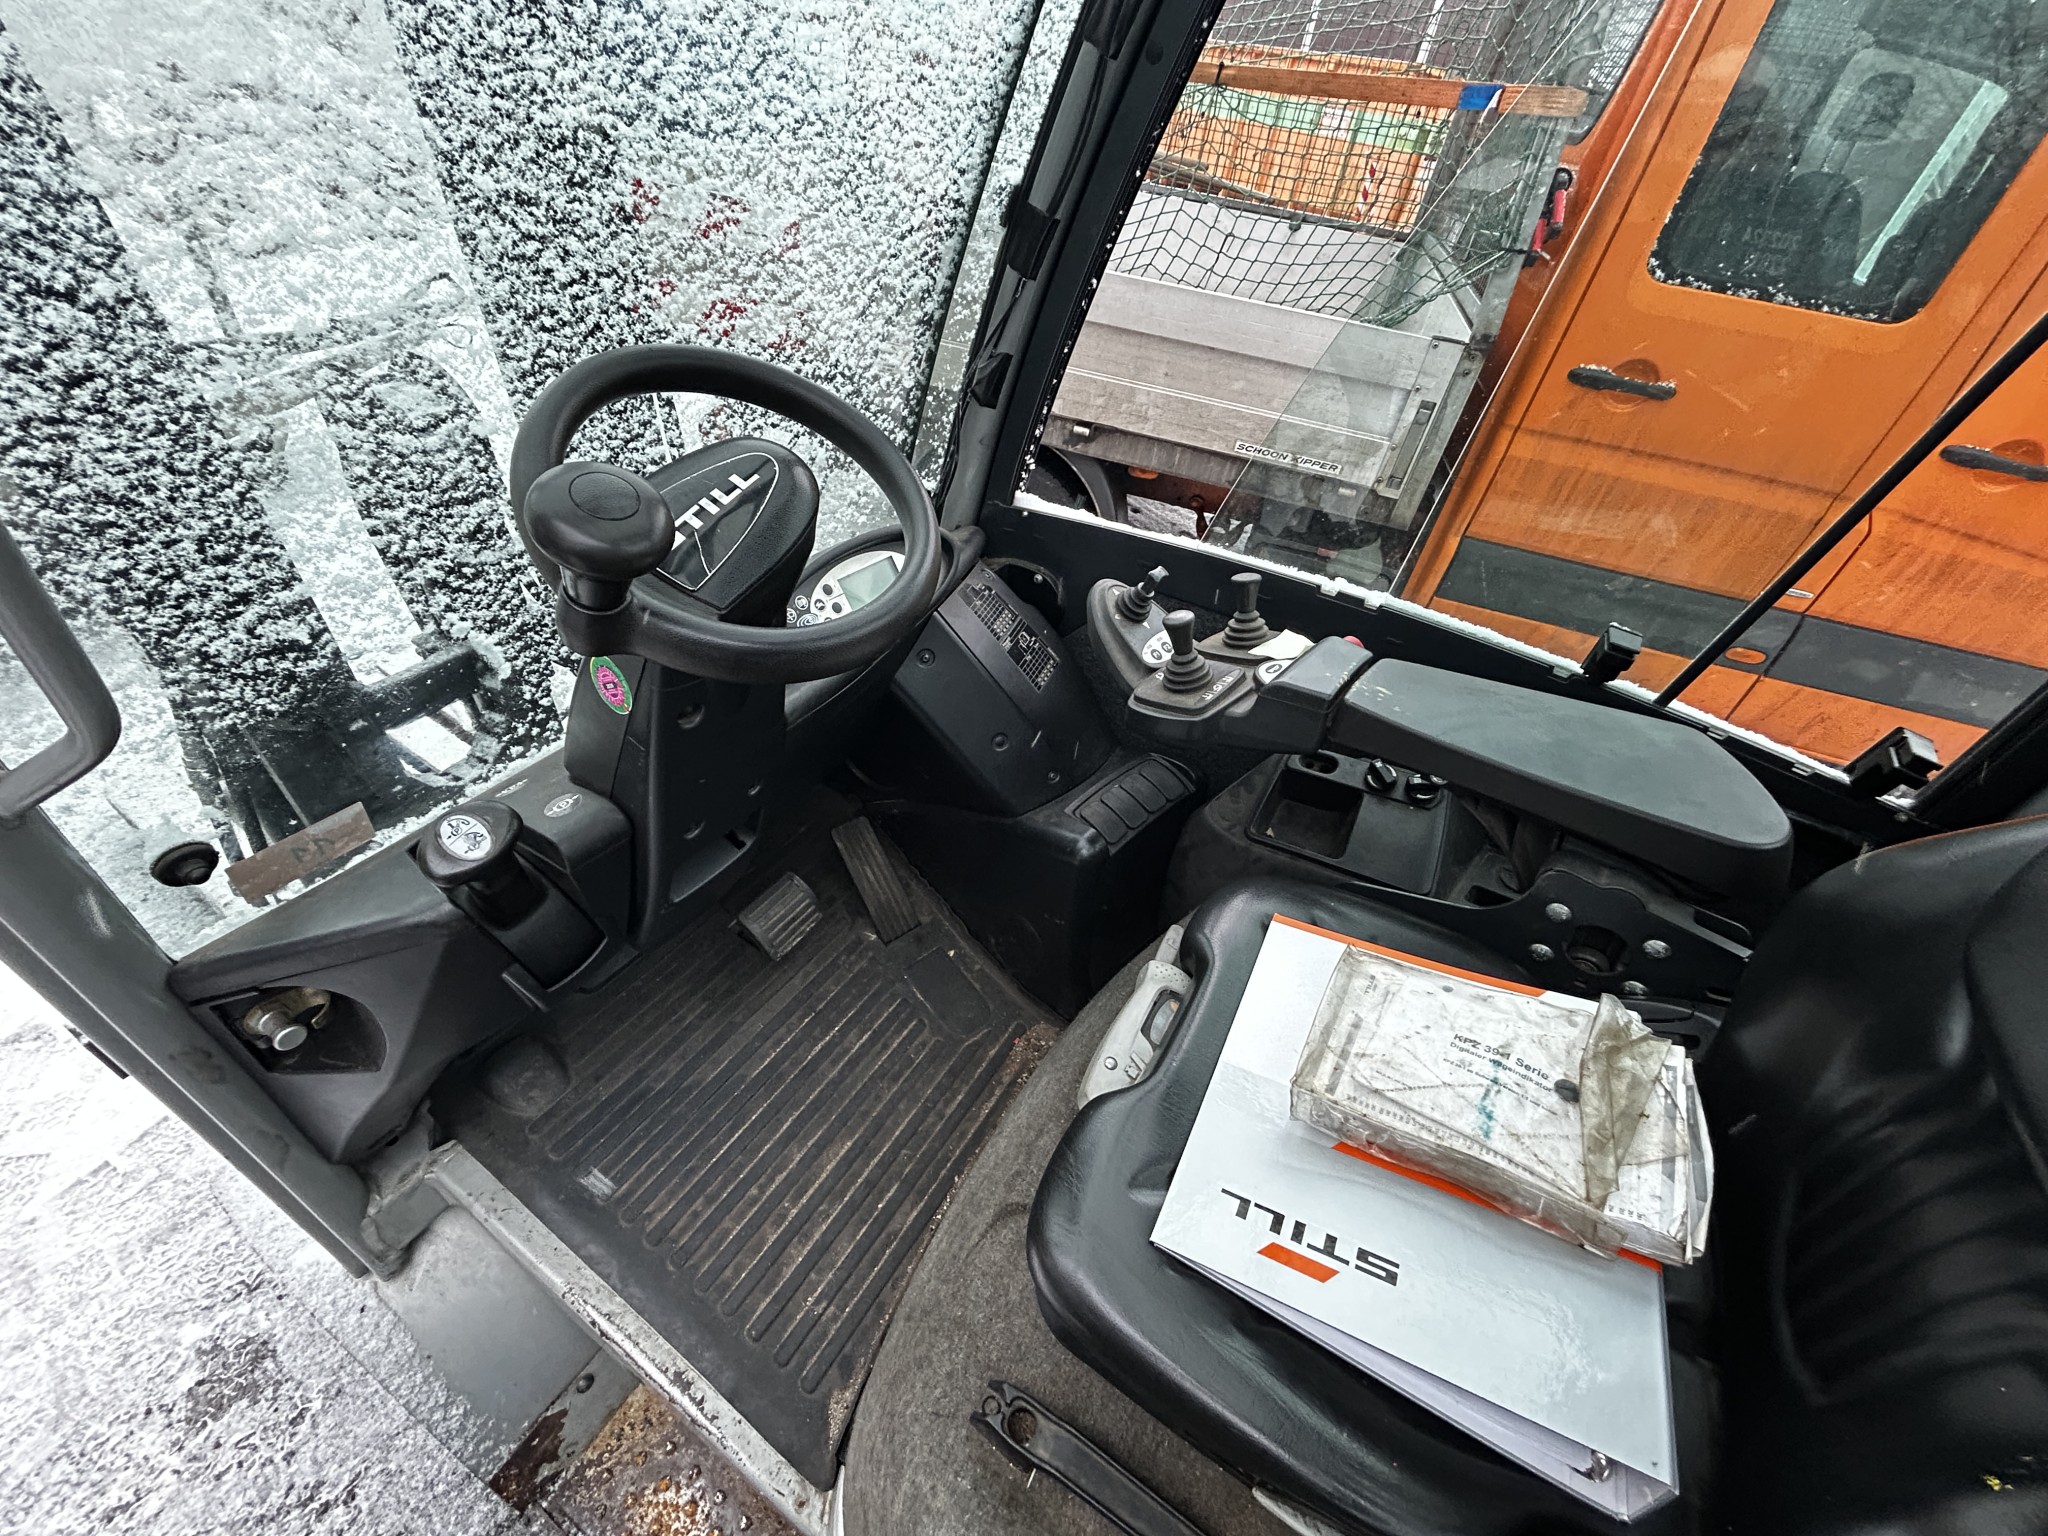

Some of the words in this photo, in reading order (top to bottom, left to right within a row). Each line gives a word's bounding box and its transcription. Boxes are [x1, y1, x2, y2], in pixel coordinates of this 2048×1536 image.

[1237, 443, 1289, 461] SCHOON
[672, 473, 760, 550] TILL
[1450, 1042, 1487, 1060] Digitaler
[1453, 1033, 1481, 1050] KPZ
[1515, 1057, 1549, 1080] Serie
[1221, 1188, 1400, 1287] STILL
